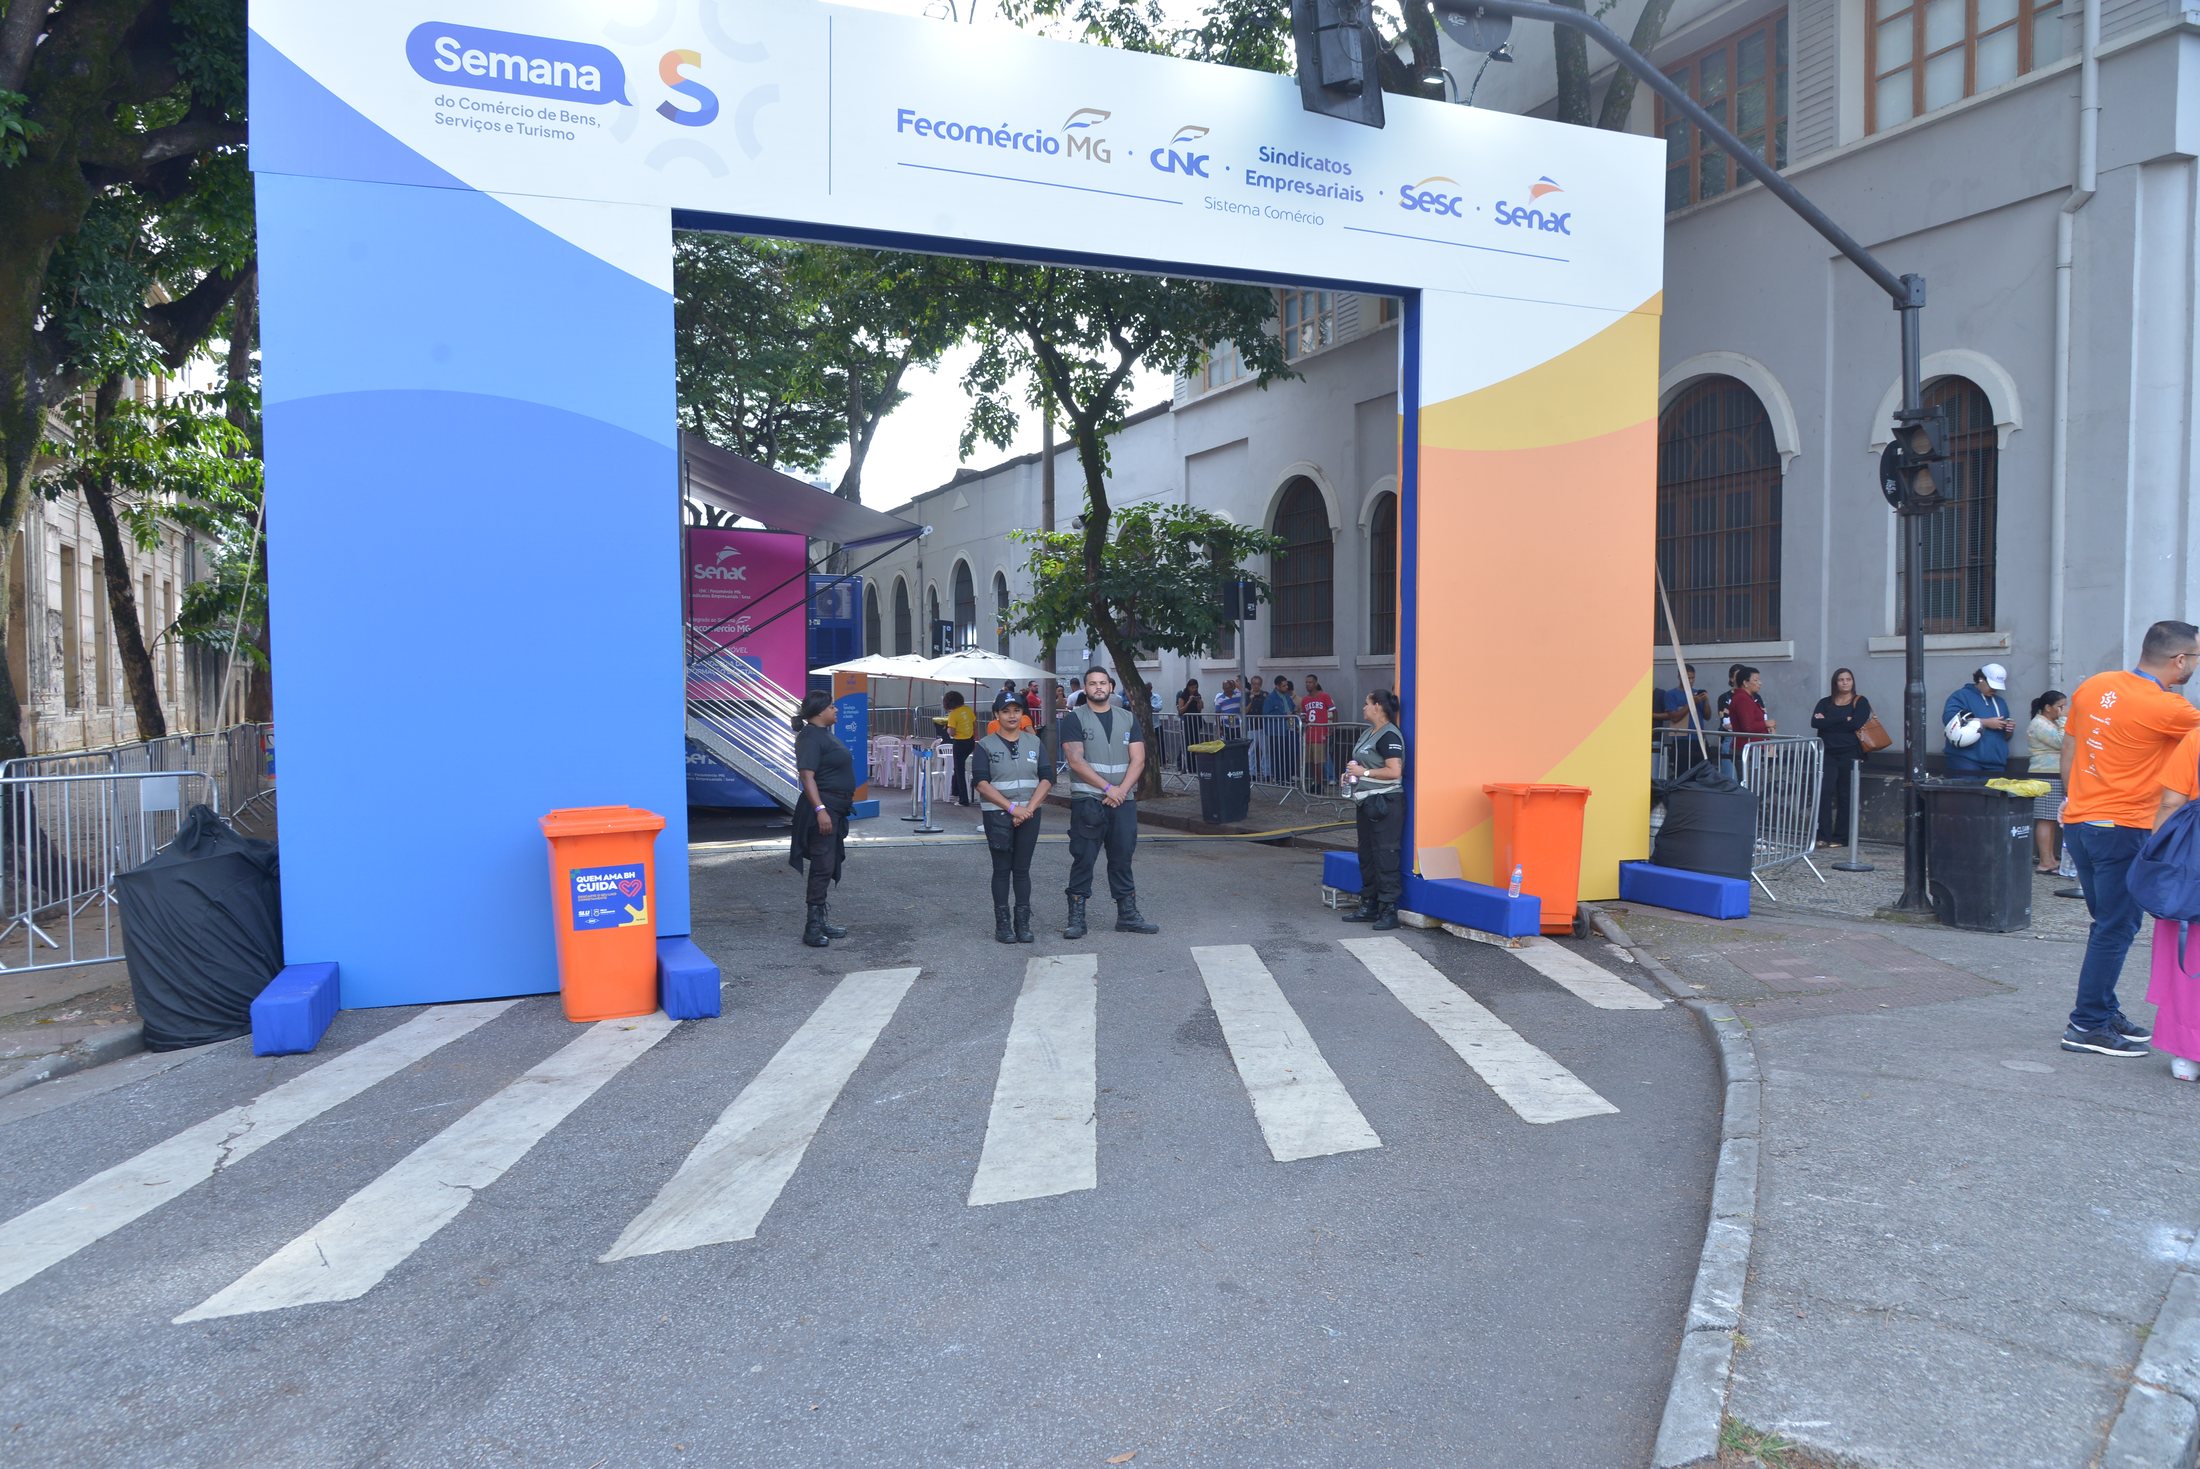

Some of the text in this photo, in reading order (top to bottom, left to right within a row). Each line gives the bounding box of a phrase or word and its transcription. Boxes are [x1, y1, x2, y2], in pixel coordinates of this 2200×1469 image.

[434, 36, 601, 92] Semana
[434, 94, 601, 129] do Comércio de Bens,
[434, 112, 575, 141] Serviços e Turismo
[897, 108, 1111, 164] Fecomércio MG
[1150, 148, 1209, 178] CNC
[1259, 146, 1352, 176] Sindicatos
[1245, 170, 1364, 202] Empresariais
[1399, 184, 1463, 218] Sesc
[1204, 196, 1324, 226] Sistema Comércio
[1495, 201, 1571, 235] Senac
[694, 564, 747, 580] Senac
[1308, 709, 1316, 722] 6
[577, 881, 618, 892] CUIDA
